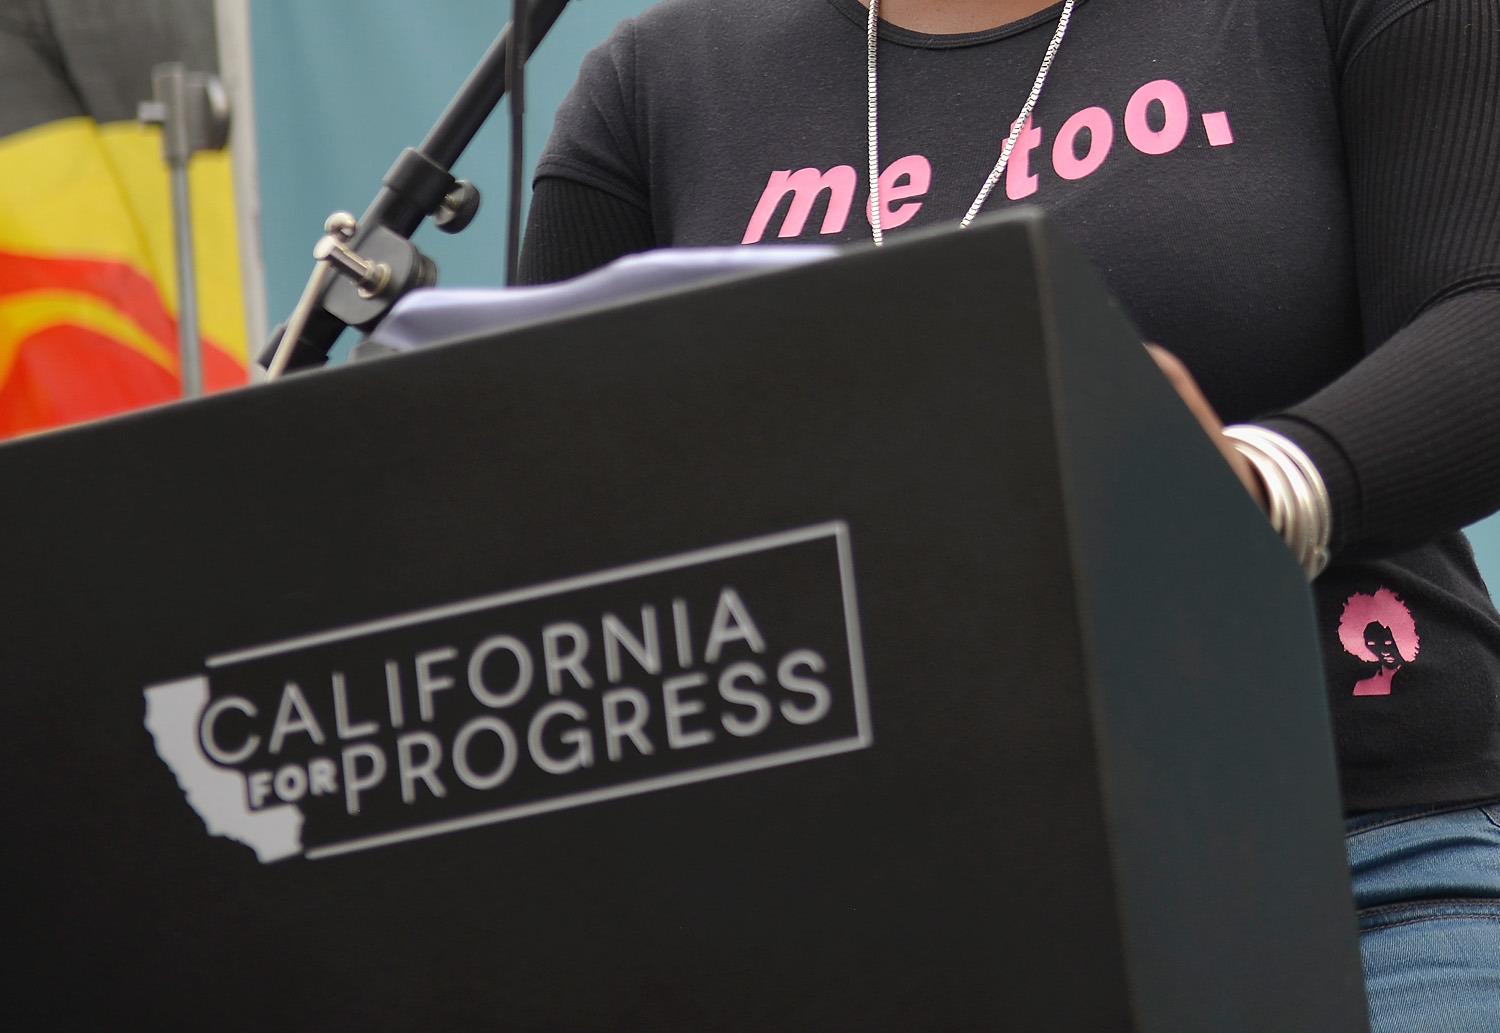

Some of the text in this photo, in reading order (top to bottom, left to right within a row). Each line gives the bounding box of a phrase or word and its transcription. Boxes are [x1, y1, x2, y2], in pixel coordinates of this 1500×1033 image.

[741, 79, 1235, 244] me too.
[201, 588, 765, 766] CALIFORNIA
[249, 649, 833, 817] FOR PROGRESS
